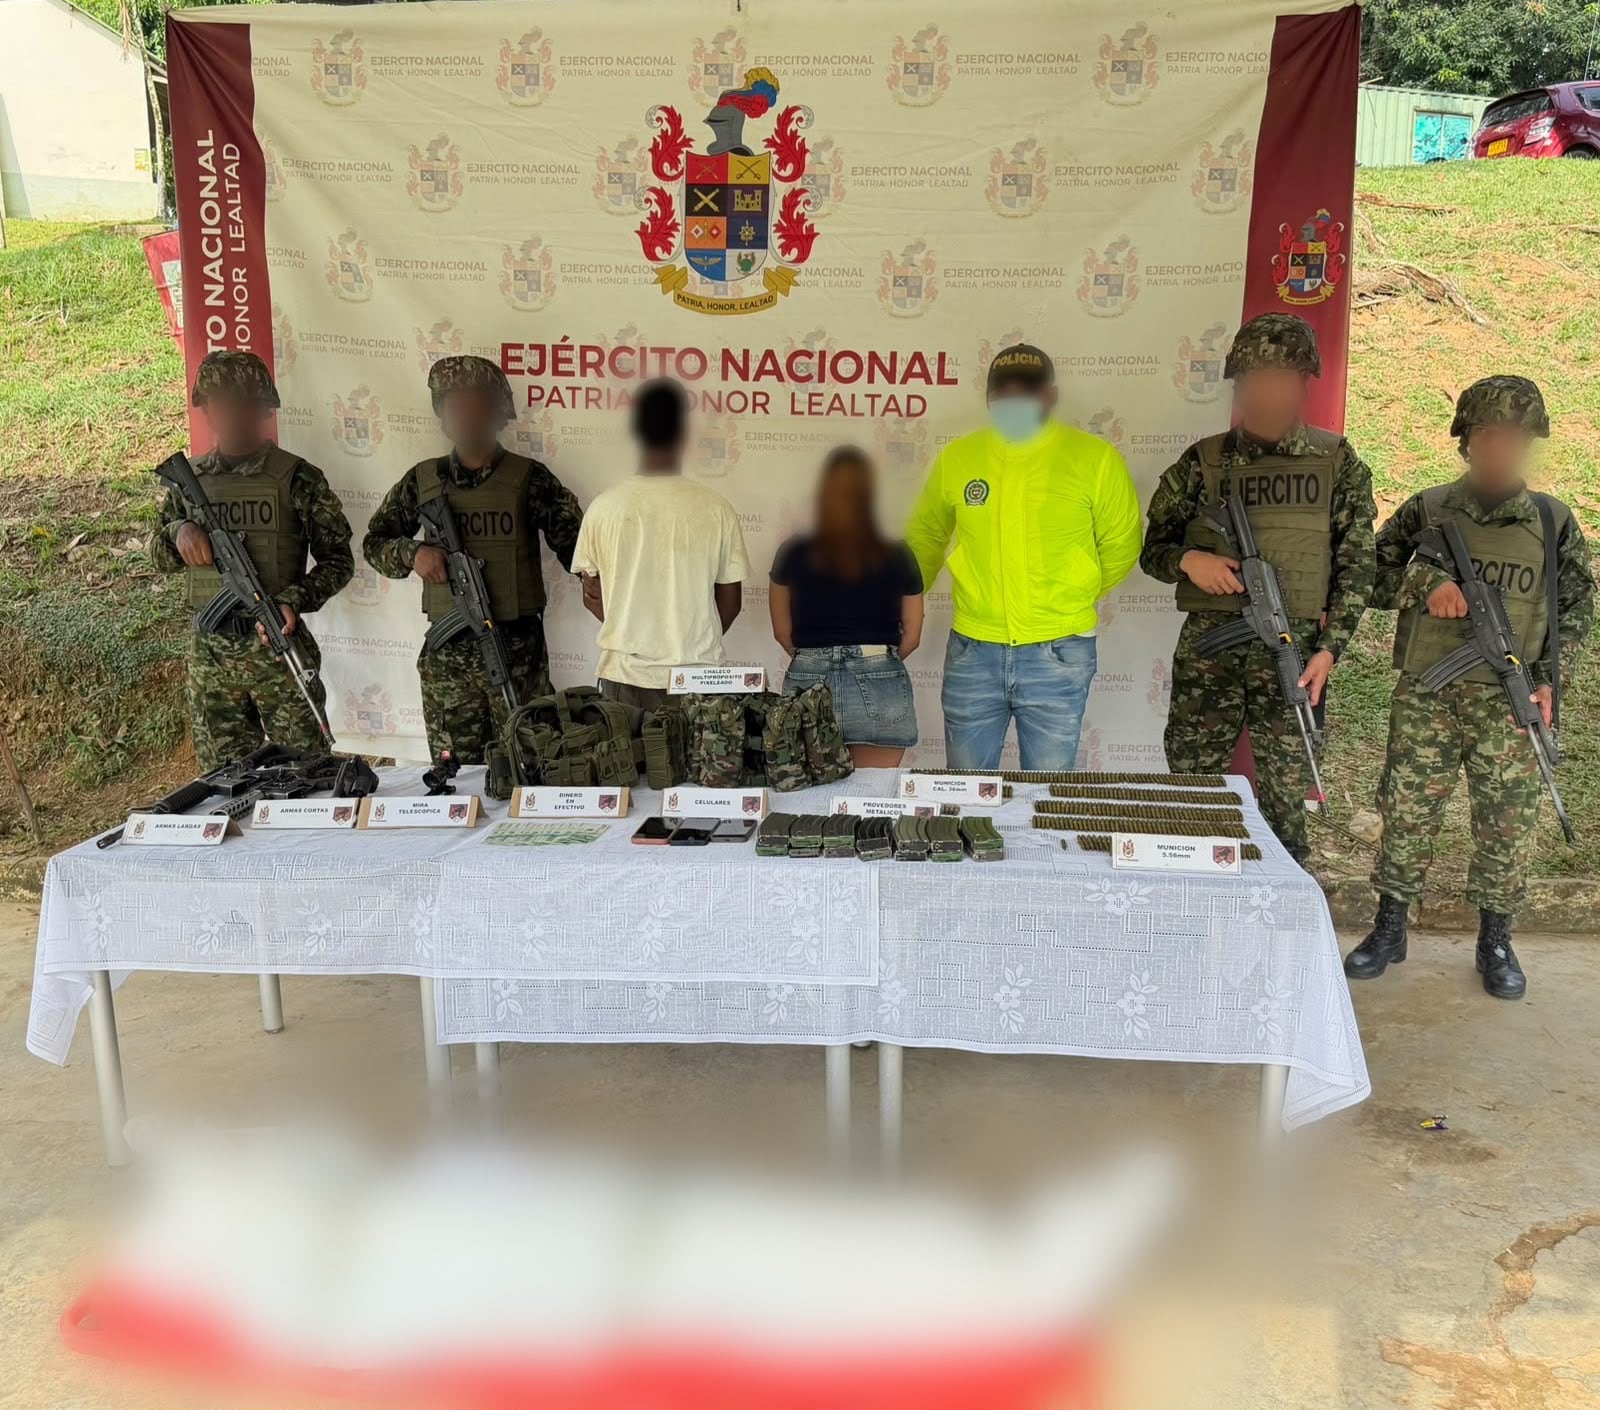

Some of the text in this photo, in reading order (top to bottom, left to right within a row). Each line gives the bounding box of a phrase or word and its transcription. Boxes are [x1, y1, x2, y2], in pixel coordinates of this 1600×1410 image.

[370, 56, 484, 66] EJERCITO NACIONAL
[559, 56, 676, 66] EJERCITO NACIONAL
[754, 55, 875, 66] EJERCITO NACIONAL
[956, 52, 1080, 65] EJERCITO NACIONAL
[1166, 52, 1224, 63] EJERCITO
[373, 68, 481, 78] PATRIA HONOR LEALTAD
[561, 68, 673, 78] PATRIA HONOR LEALTAD
[792, 68, 830, 77] HONOR
[833, 68, 872, 77] LEALTAD
[957, 66, 1078, 76] PATRIA HONOR LEALTAD
[1167, 65, 1201, 75] PATRIA
[1206, 66, 1242, 75] HONOR
[282, 158, 394, 173] EJERCITO NACIONAL
[466, 162, 580, 174] EJERCITO NACIONAL
[1054, 161, 1181, 177] EJERCITO NACIONAL
[286, 170, 392, 184] PATRIA HONOR LEALTAD
[851, 166, 972, 177] EJERCITO NACIONAL
[469, 175, 578, 186] PATRIA HONOR LEALTAD
[853, 179, 968, 188] PATRIA HONOR LEALTAD
[1056, 174, 1178, 188] PATRIA HONOR LEALTAD
[222, 142, 246, 253] LEALTAD
[197, 129, 226, 307] NACIONAL
[374, 258, 488, 272] EJERCITO NACIONAL
[560, 263, 612, 274] EJERCITO
[1145, 264, 1201, 277] EJERCITO
[377, 270, 485, 282] PATRIA HONOR LEALTAD
[804, 267, 864, 278] NACIONAL
[944, 267, 1066, 279] EJERCITO NACIONAL
[562, 275, 592, 284] PATRIA
[596, 276, 628, 285] HONOR
[824, 280, 862, 289] LEALTAD
[945, 280, 1062, 289] PATRIA HONOR LEALTAD
[1146, 278, 1178, 287] PATRIA
[1182, 276, 1218, 286] HONOR
[739, 294, 774, 310] LEALTAD
[298, 332, 406, 350] EJERCITO NACIONAL
[331, 348, 366, 358] HONOR
[368, 350, 406, 360] LEALTAD
[500, 335, 708, 382] EJÉRCITO
[720, 348, 959, 386] NACIONAL
[1098, 355, 1160, 366] NACIONAL
[1078, 368, 1113, 377] HONOR
[1116, 368, 1158, 377] LEALTAD
[790, 392, 928, 418] LEALTAD
[744, 431, 798, 442] EJERCITO
[1130, 434, 1188, 446] EJERCITO
[746, 444, 778, 452] PATRIA
[1118, 594, 1174, 604] EJERCITO
[1120, 606, 1151, 614] PATRIA
[362, 638, 416, 650] NACIONAL
[379, 650, 413, 659] LEALTAD
[1108, 744, 1161, 754] EJERCITO
[1109, 754, 1140, 762] PATRIA
[863, 802, 907, 810] PROVEDORES
[865, 808, 904, 816] METALICOS
[1157, 844, 1196, 852] MUNICION
